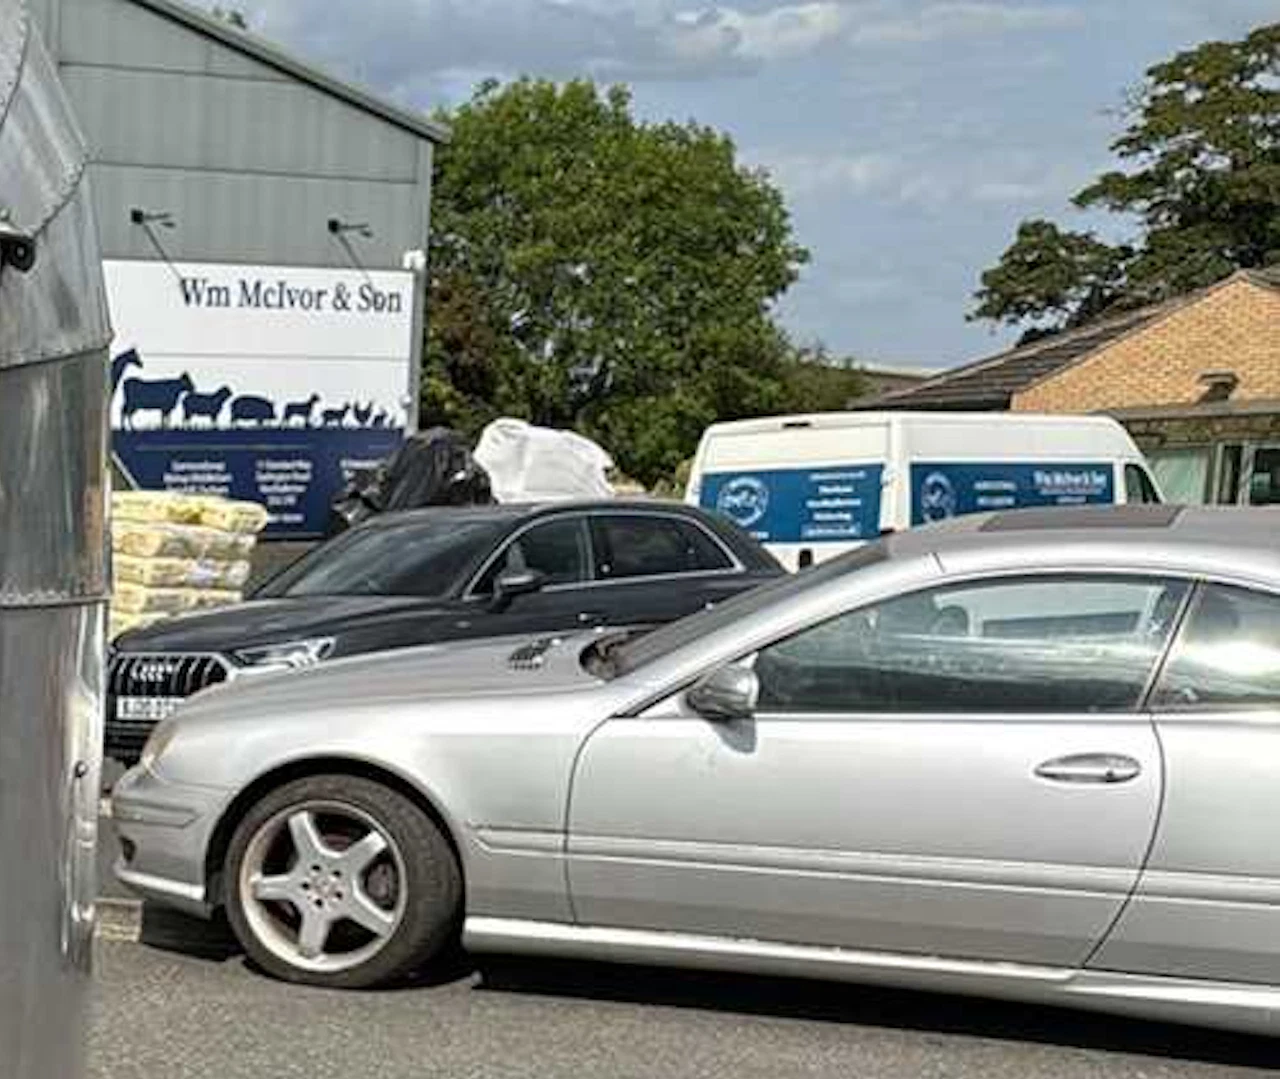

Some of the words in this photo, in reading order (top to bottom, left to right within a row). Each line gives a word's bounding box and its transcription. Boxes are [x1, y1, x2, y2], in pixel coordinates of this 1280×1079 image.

[181, 278, 231, 307] Wm
[238, 279, 328, 310] McIvor
[332, 281, 351, 311] &
[357, 283, 402, 312] Son
